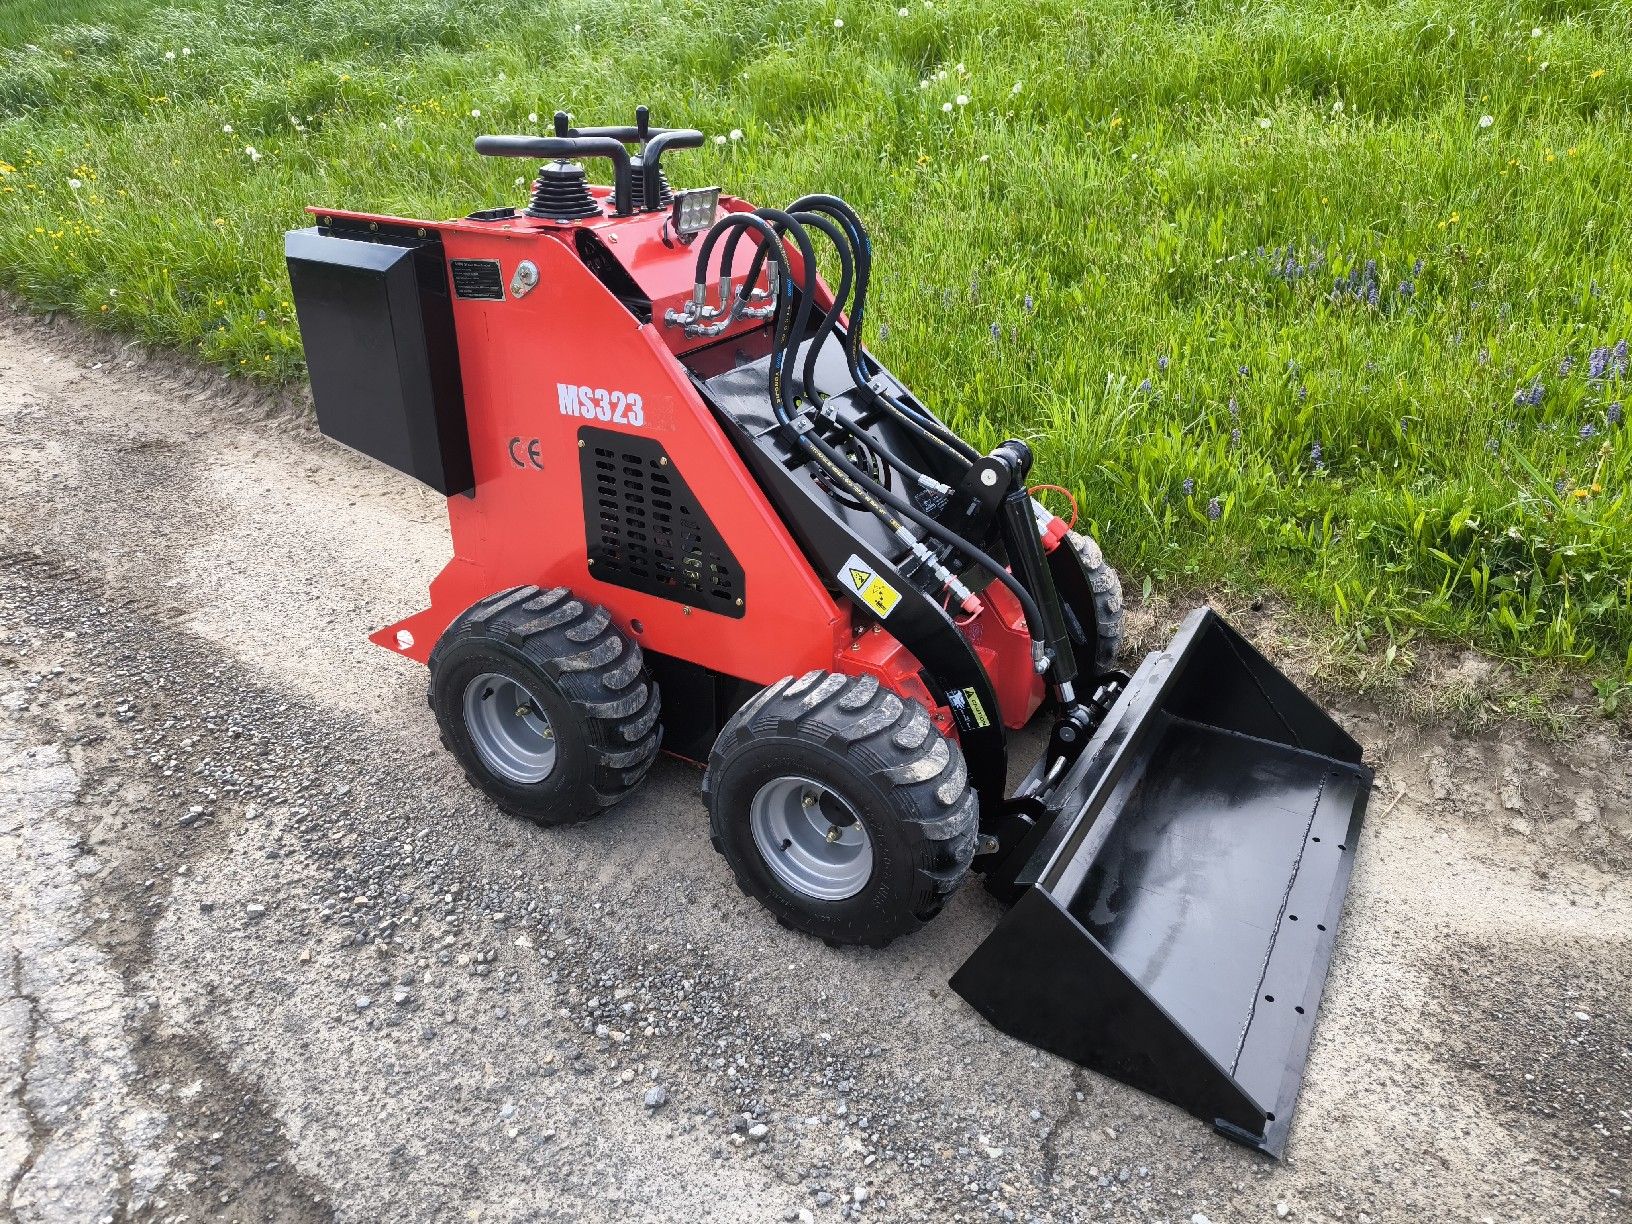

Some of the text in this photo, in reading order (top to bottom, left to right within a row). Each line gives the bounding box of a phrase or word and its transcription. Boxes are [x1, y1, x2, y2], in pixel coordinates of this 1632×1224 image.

[556, 382, 645, 427] MS323
[508, 436, 545, 470] CE
[971, 699, 987, 726] CAUTION
